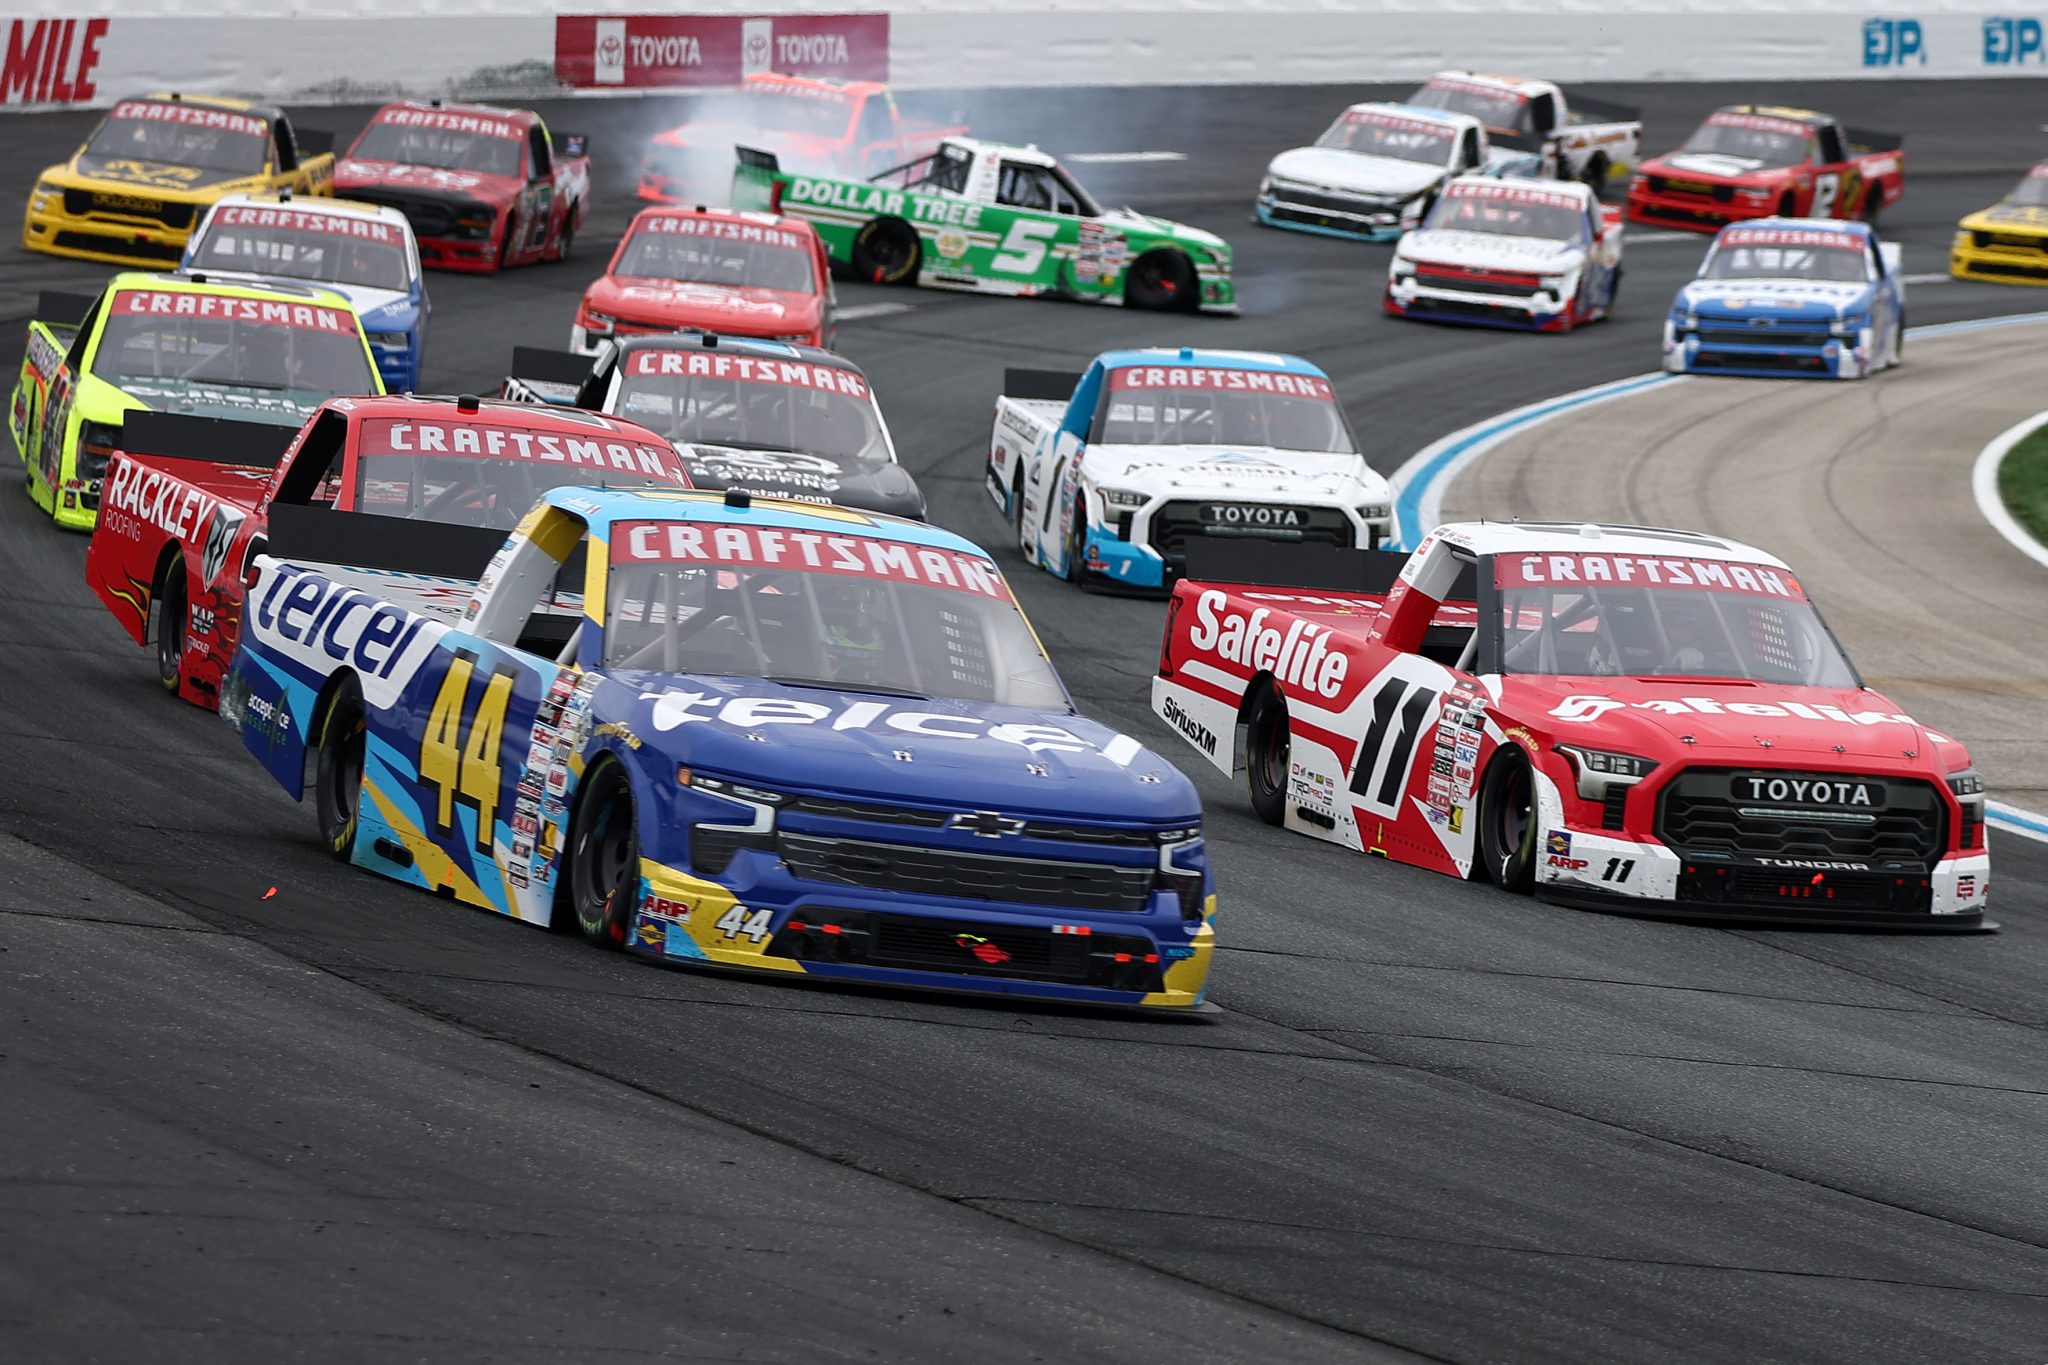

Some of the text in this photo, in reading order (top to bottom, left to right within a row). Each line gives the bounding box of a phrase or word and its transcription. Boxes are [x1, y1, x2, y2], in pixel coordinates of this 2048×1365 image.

[0, 19, 110, 104] MILE
[630, 36, 701, 66] TOYOTA
[776, 34, 848, 64] TOYOTA
[116, 102, 263, 137] CRAFTSMAN
[384, 110, 510, 137] CRAFTSMAN
[791, 178, 983, 228] DOLLAR TREE
[222, 207, 390, 241] CRAFTSMAN
[648, 217, 798, 248] CRAFTSMAN
[991, 218, 1060, 275] 5
[129, 293, 338, 331] CRAFTSMAN
[638, 352, 861, 397] CRAFTSMAN
[1126, 367, 1318, 398] CRAFTSMAN
[391, 422, 667, 478] CRAFTSMAN
[109, 458, 217, 544] RACKLEY
[1212, 506, 1299, 525] TOYOTA
[105, 509, 141, 542] ROOFING
[630, 525, 1003, 598] CRAFTSMAN
[1521, 556, 1791, 598] CRAFTSMAN
[1190, 590, 1348, 699] Safelite
[1162, 695, 1218, 758] SiriusXM
[1349, 677, 1438, 807] 11
[419, 650, 517, 855] 44
[1456, 746, 1477, 763] SKF
[1747, 777, 1872, 806] TOYOTA
[1547, 855, 1589, 870] ARP
[1602, 857, 1636, 883] 11
[1754, 856, 1870, 871] TUNDRA
[642, 895, 690, 918] ARP
[714, 903, 774, 944] 44
